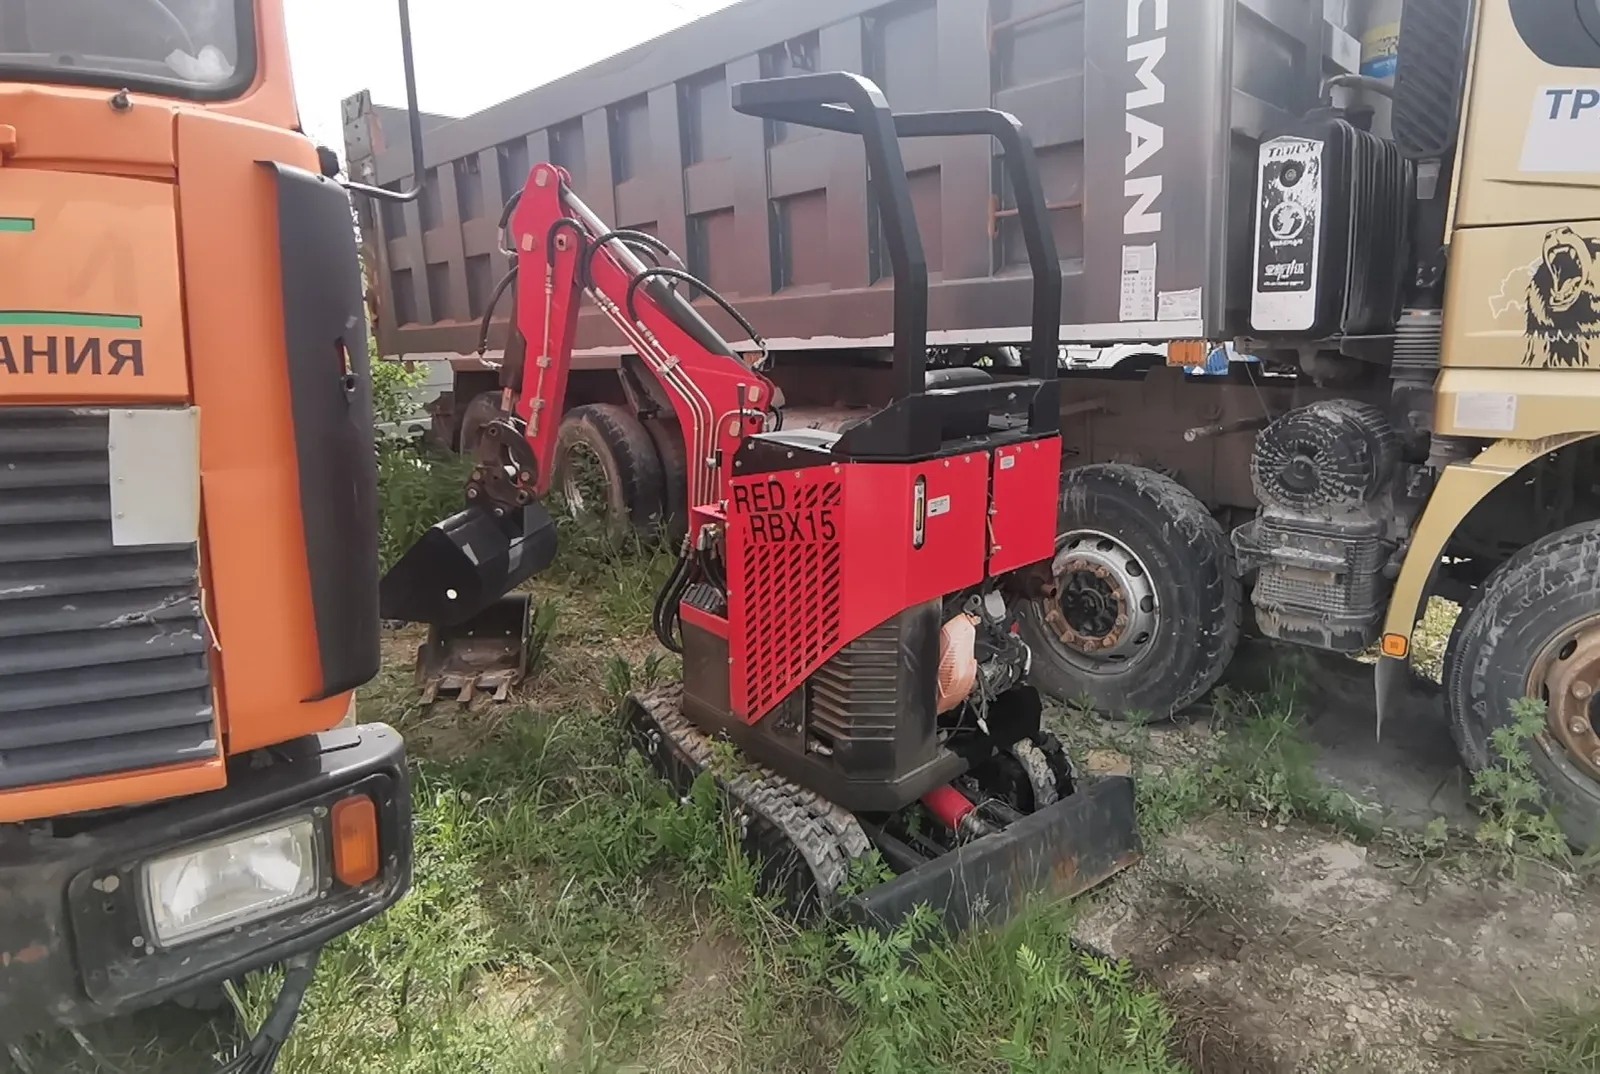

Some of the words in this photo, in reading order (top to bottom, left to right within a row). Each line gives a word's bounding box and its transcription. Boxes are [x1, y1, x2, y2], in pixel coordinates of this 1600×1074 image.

[1546, 89, 1600, 119] ТР
[733, 481, 786, 514] RED
[749, 510, 836, 544] RBX15
